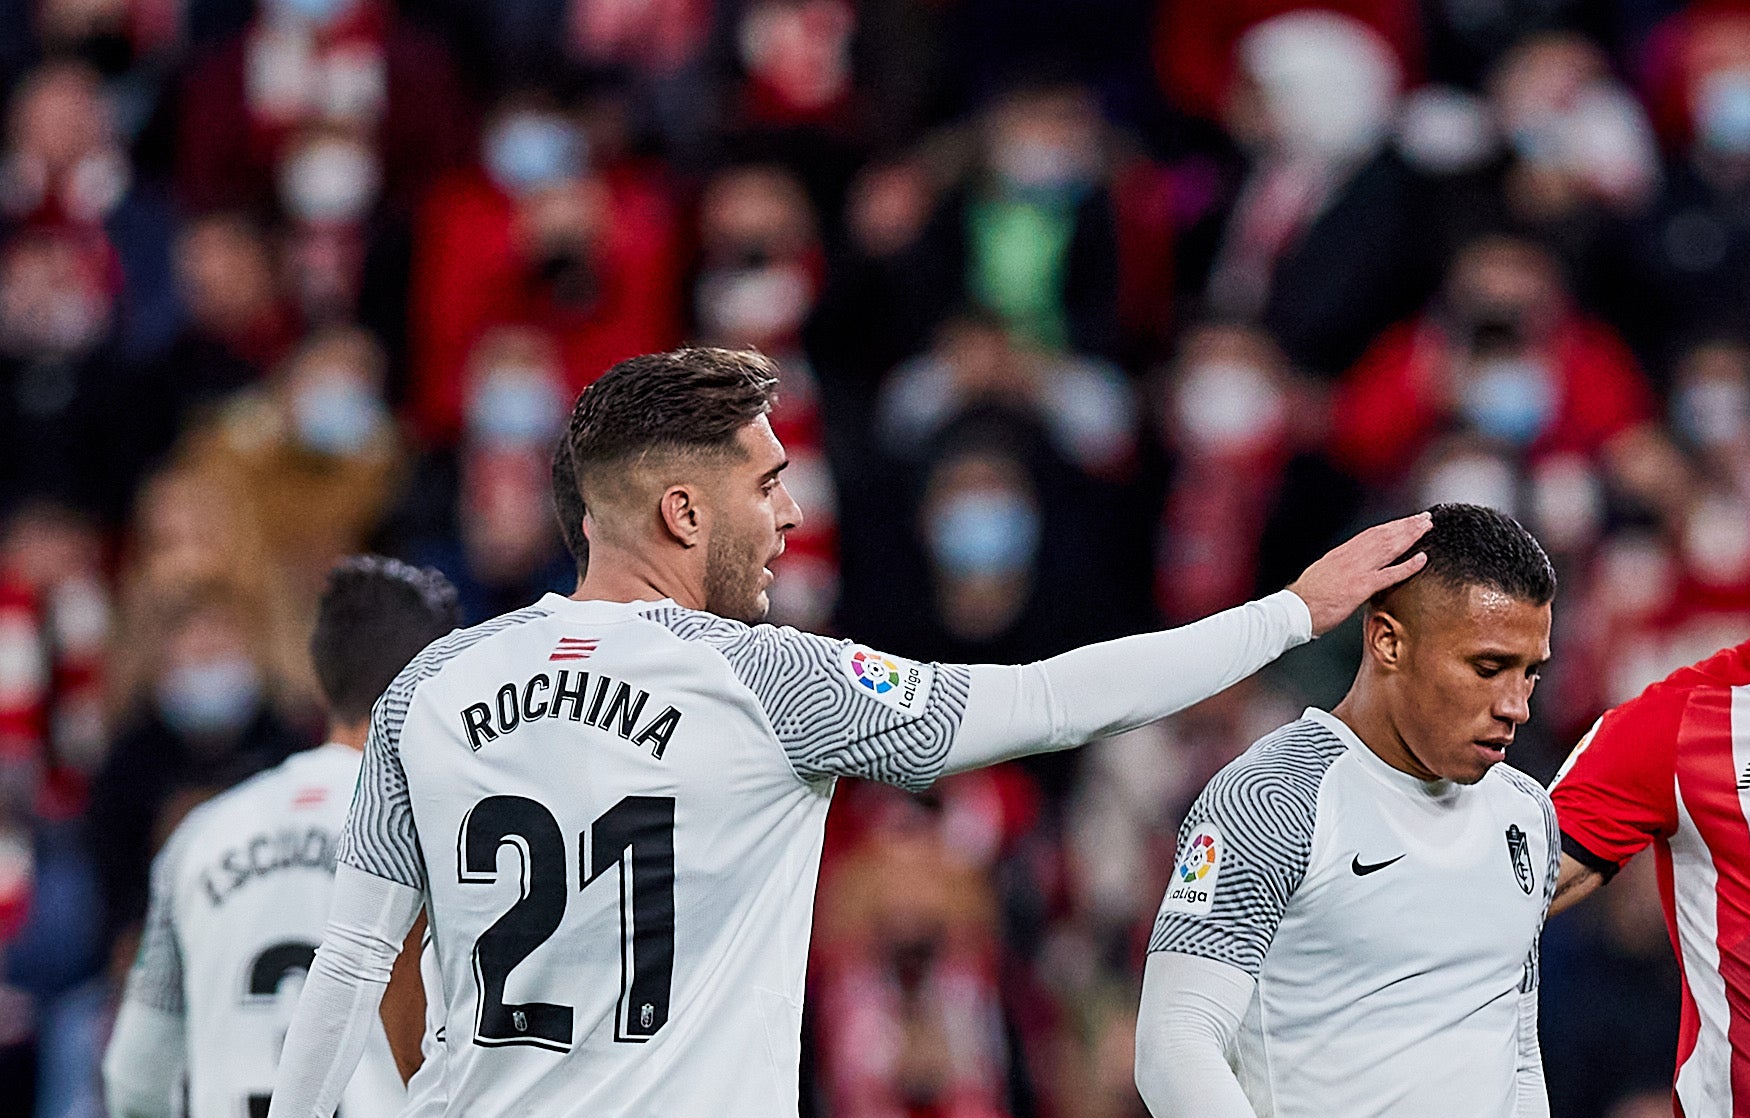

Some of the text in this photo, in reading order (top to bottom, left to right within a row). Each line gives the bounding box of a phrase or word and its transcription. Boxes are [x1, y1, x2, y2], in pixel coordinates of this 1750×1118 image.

[460, 669, 683, 761] ROCHINA
[899, 667, 921, 709] LaLiga
[457, 794, 677, 1054] 21
